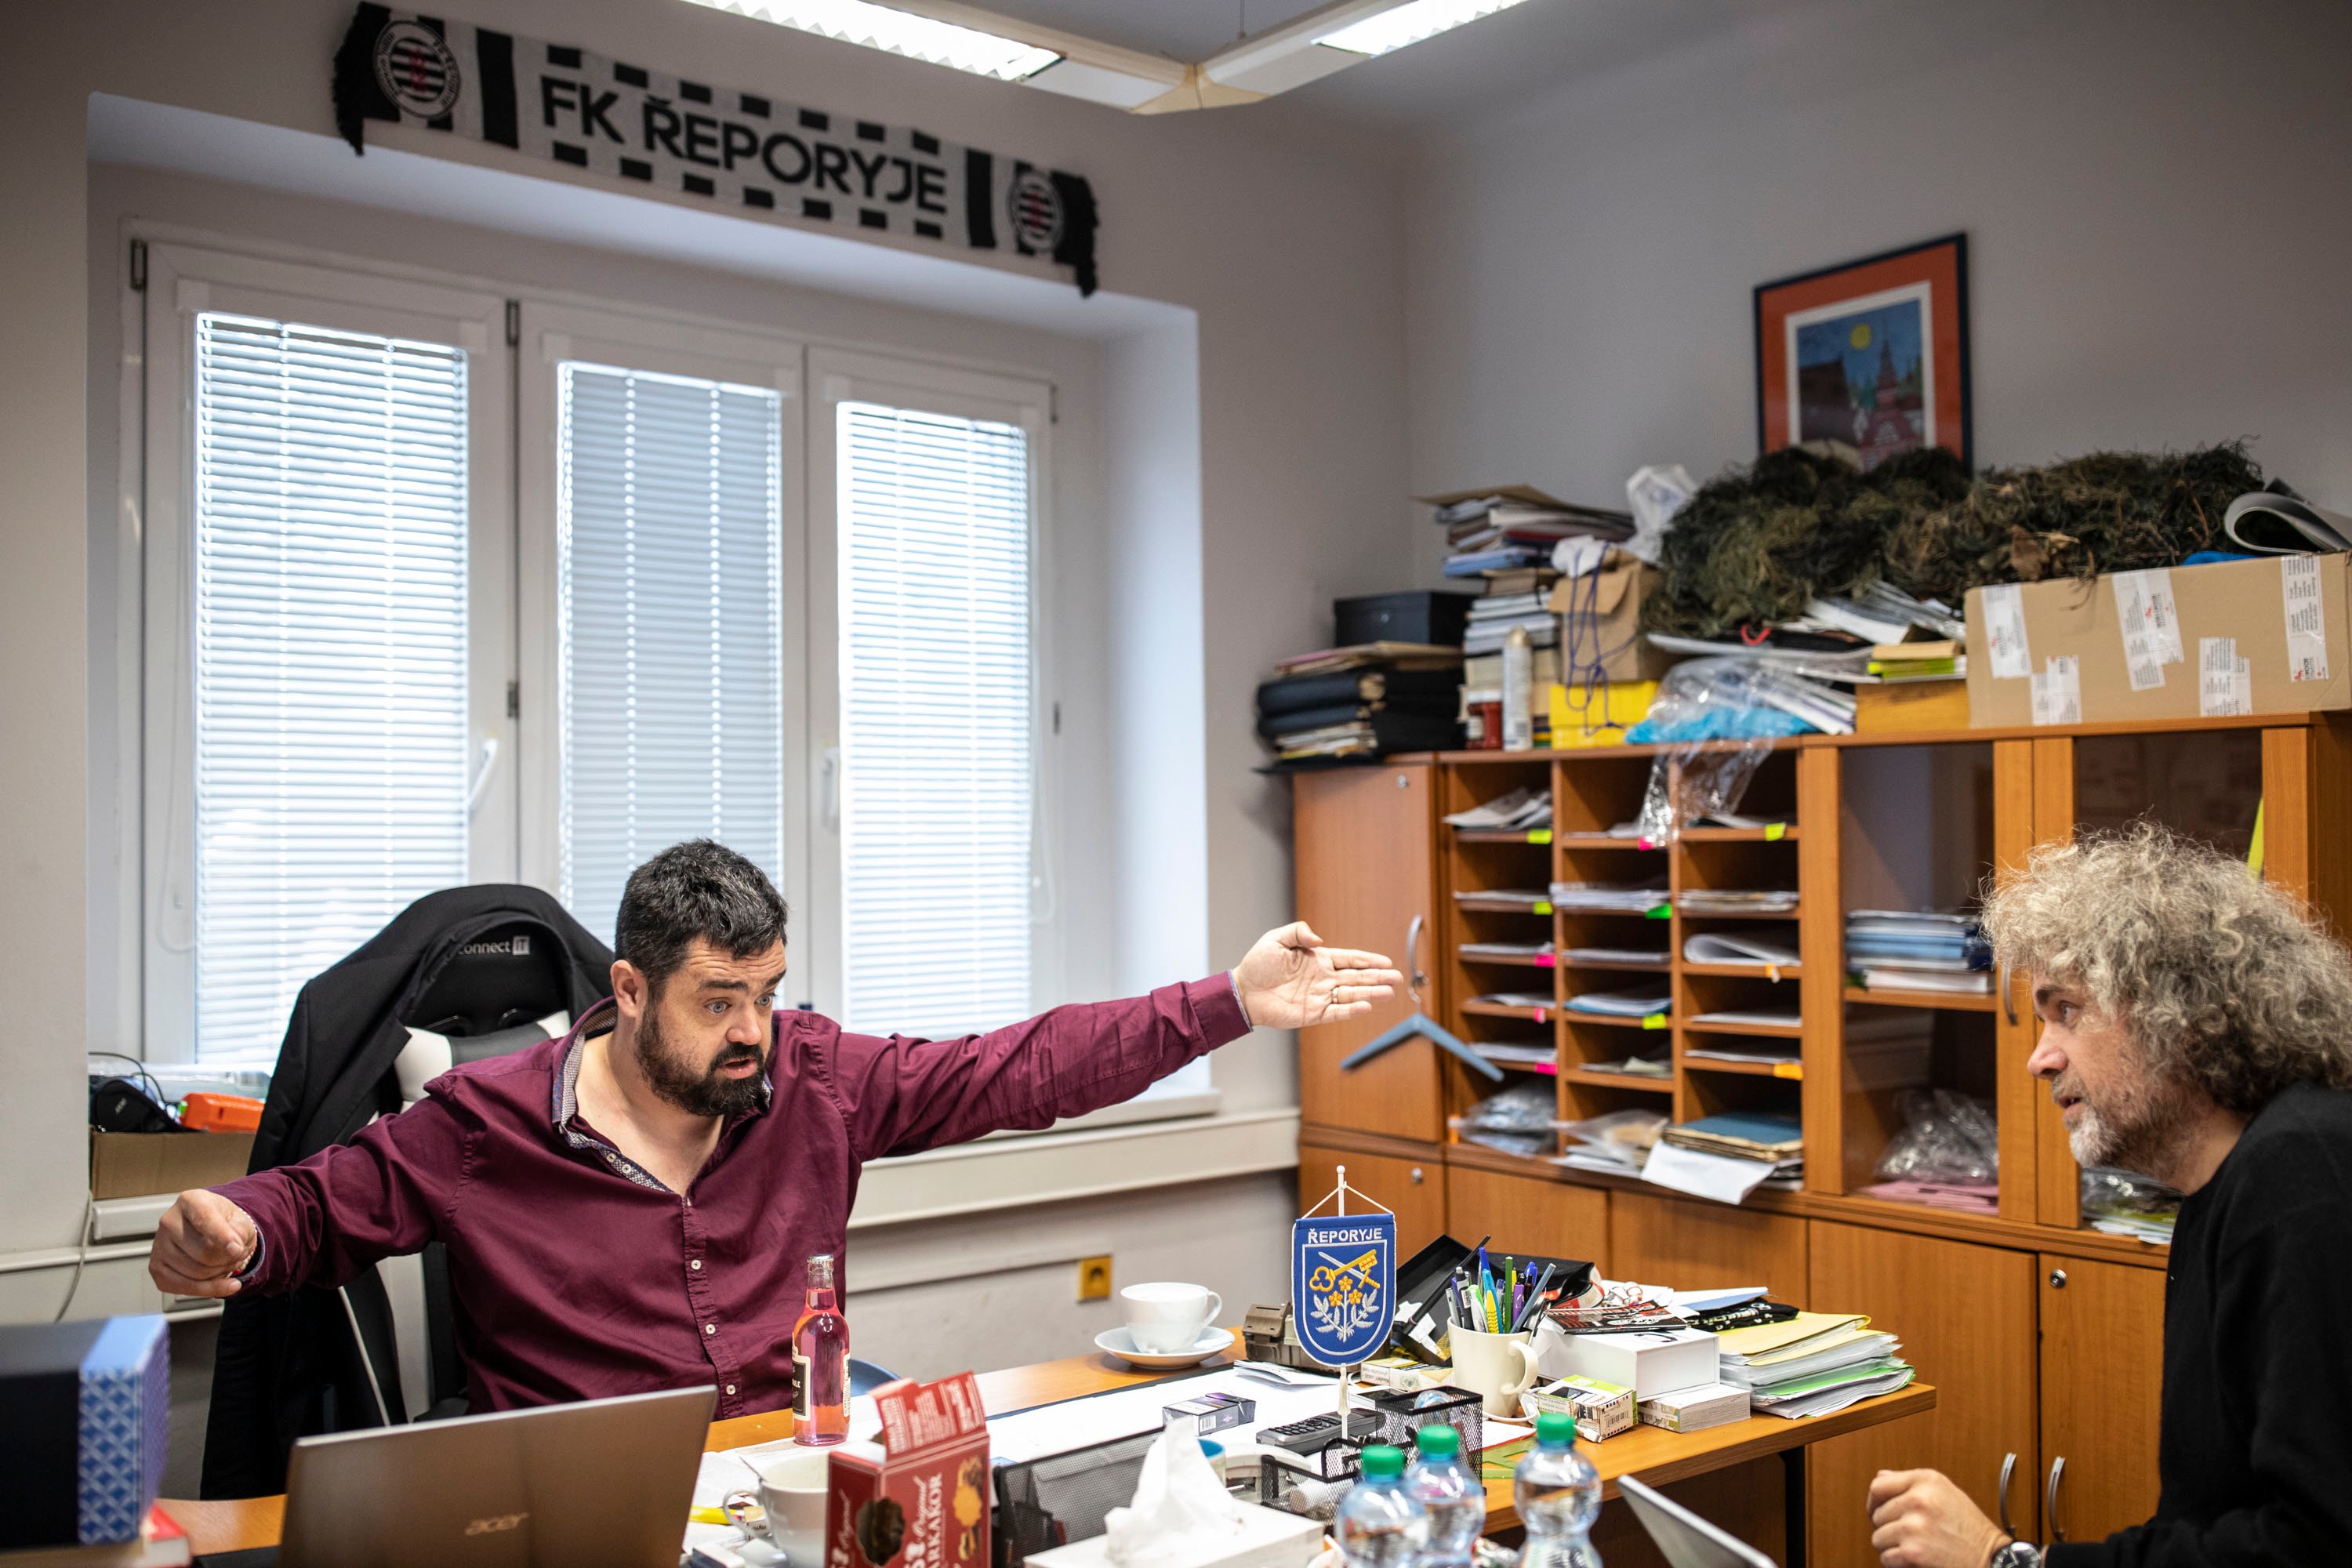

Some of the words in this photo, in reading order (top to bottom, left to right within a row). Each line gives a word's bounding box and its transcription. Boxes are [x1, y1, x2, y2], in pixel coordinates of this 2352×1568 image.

[540, 74, 626, 145] FK
[642, 94, 947, 215] ŘEPORYJE
[514, 937, 528, 953] IT
[1307, 1228, 1383, 1245] ŘEPORYJE
[465, 1513, 529, 1536] acer
